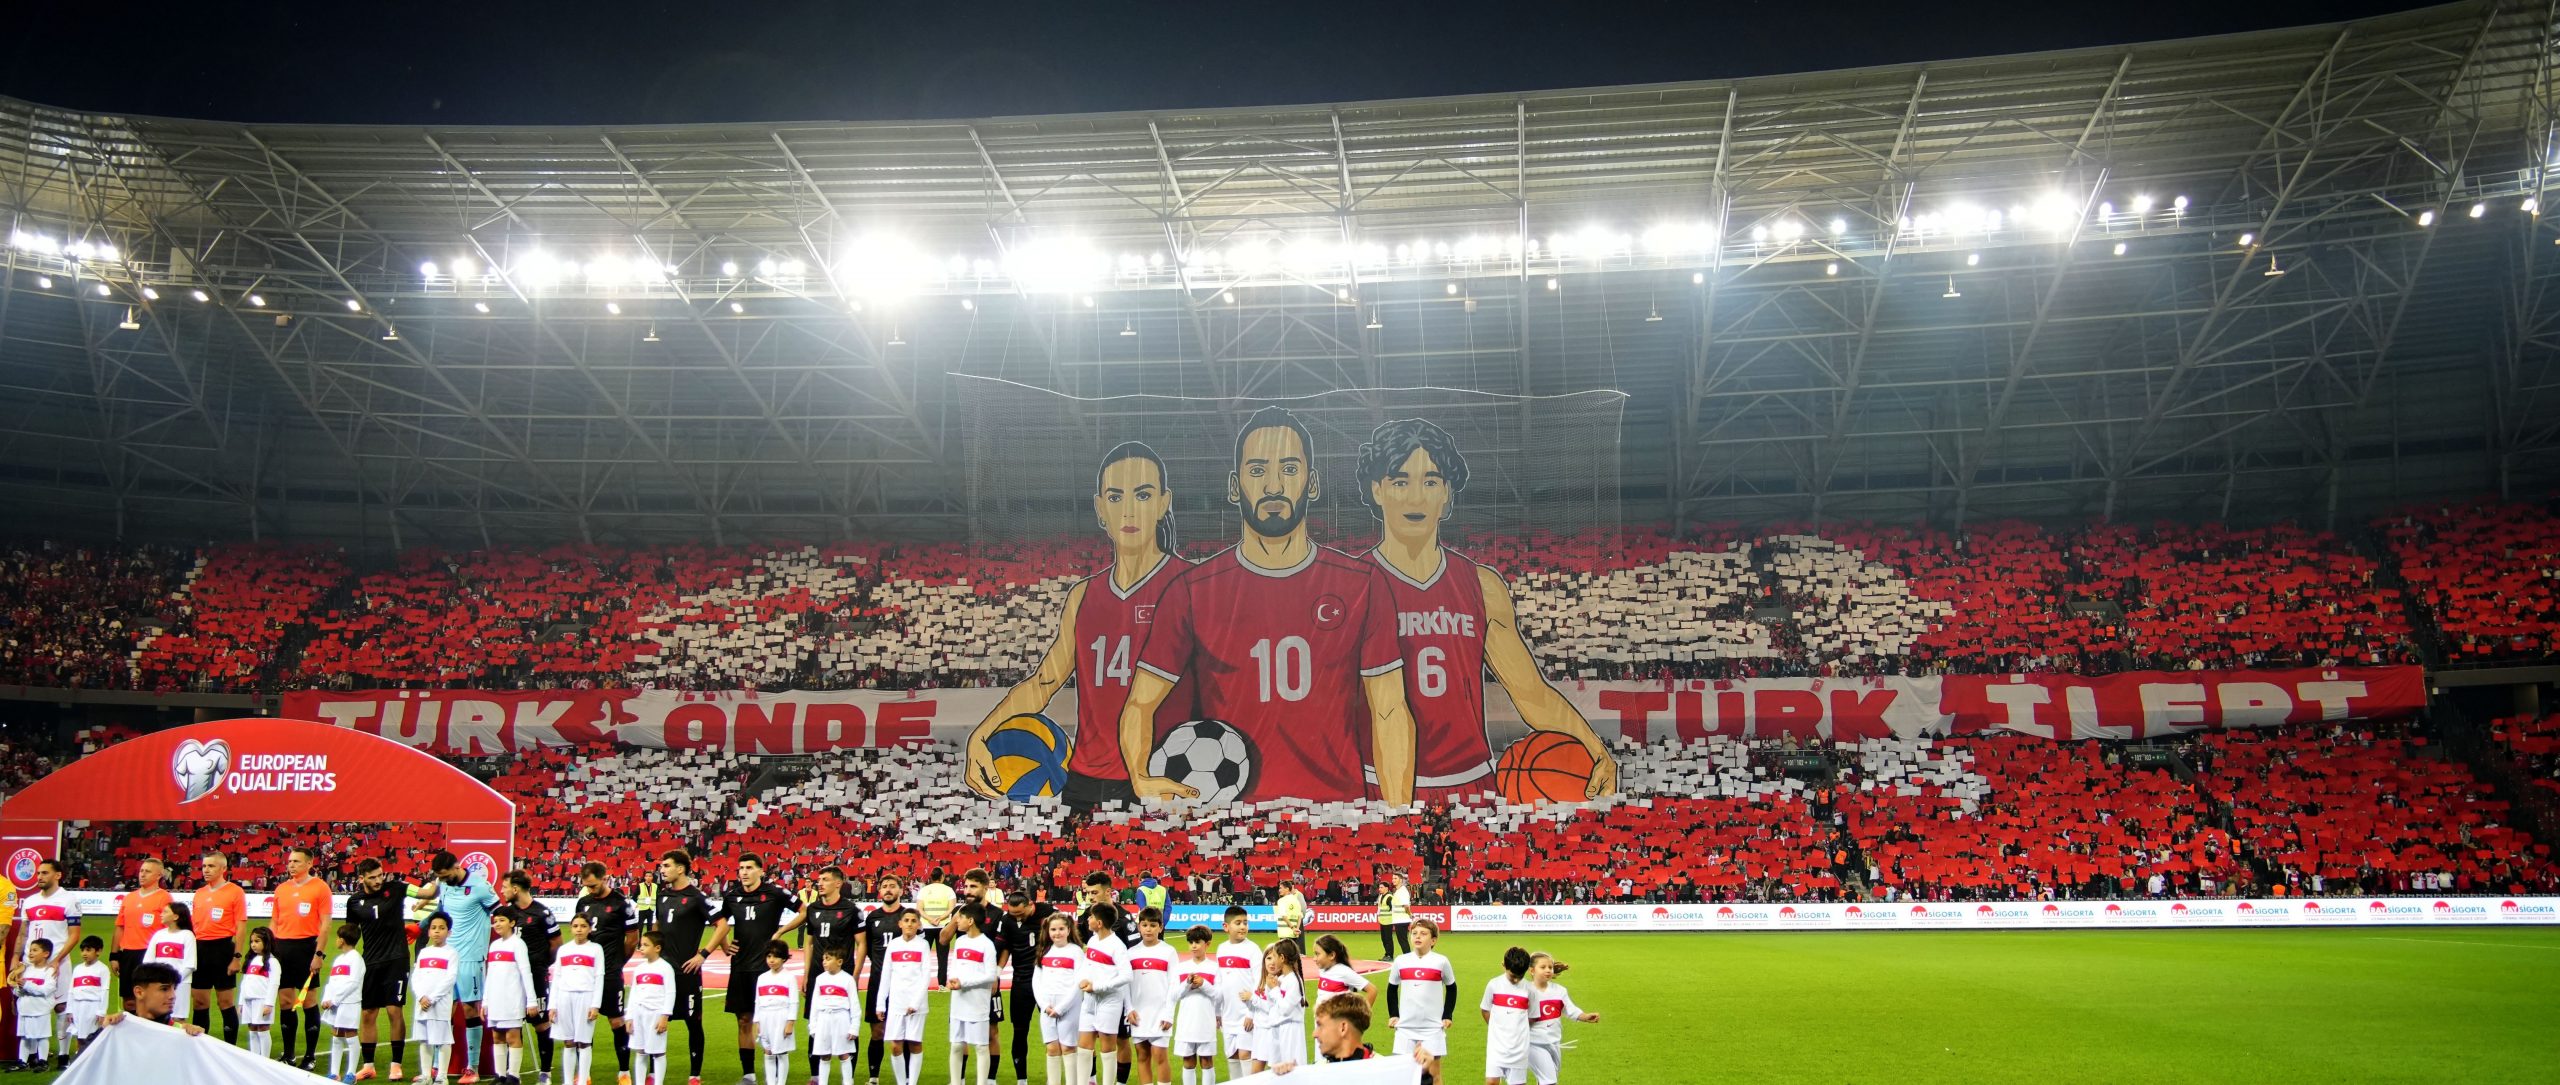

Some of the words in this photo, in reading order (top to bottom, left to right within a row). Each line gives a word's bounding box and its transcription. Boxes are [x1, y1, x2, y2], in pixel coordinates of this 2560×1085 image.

[1090, 635, 1132, 686] 14
[1250, 636, 1312, 702] 10
[1417, 646, 1446, 698] 6
[318, 690, 575, 754] TÜRK
[1599, 680, 1898, 750] TÜRK
[240, 754, 328, 770] EUROPEAN
[228, 772, 337, 794] QUALIFIERS
[14, 851, 38, 860] UEFA
[466, 855, 490, 866] UEFA
[745, 906, 756, 920] 14
[1317, 913, 1377, 923] EUROPEAN
[592, 916, 598, 931] 2
[1029, 932, 1035, 947] 6
[473, 976, 477, 989] 1
